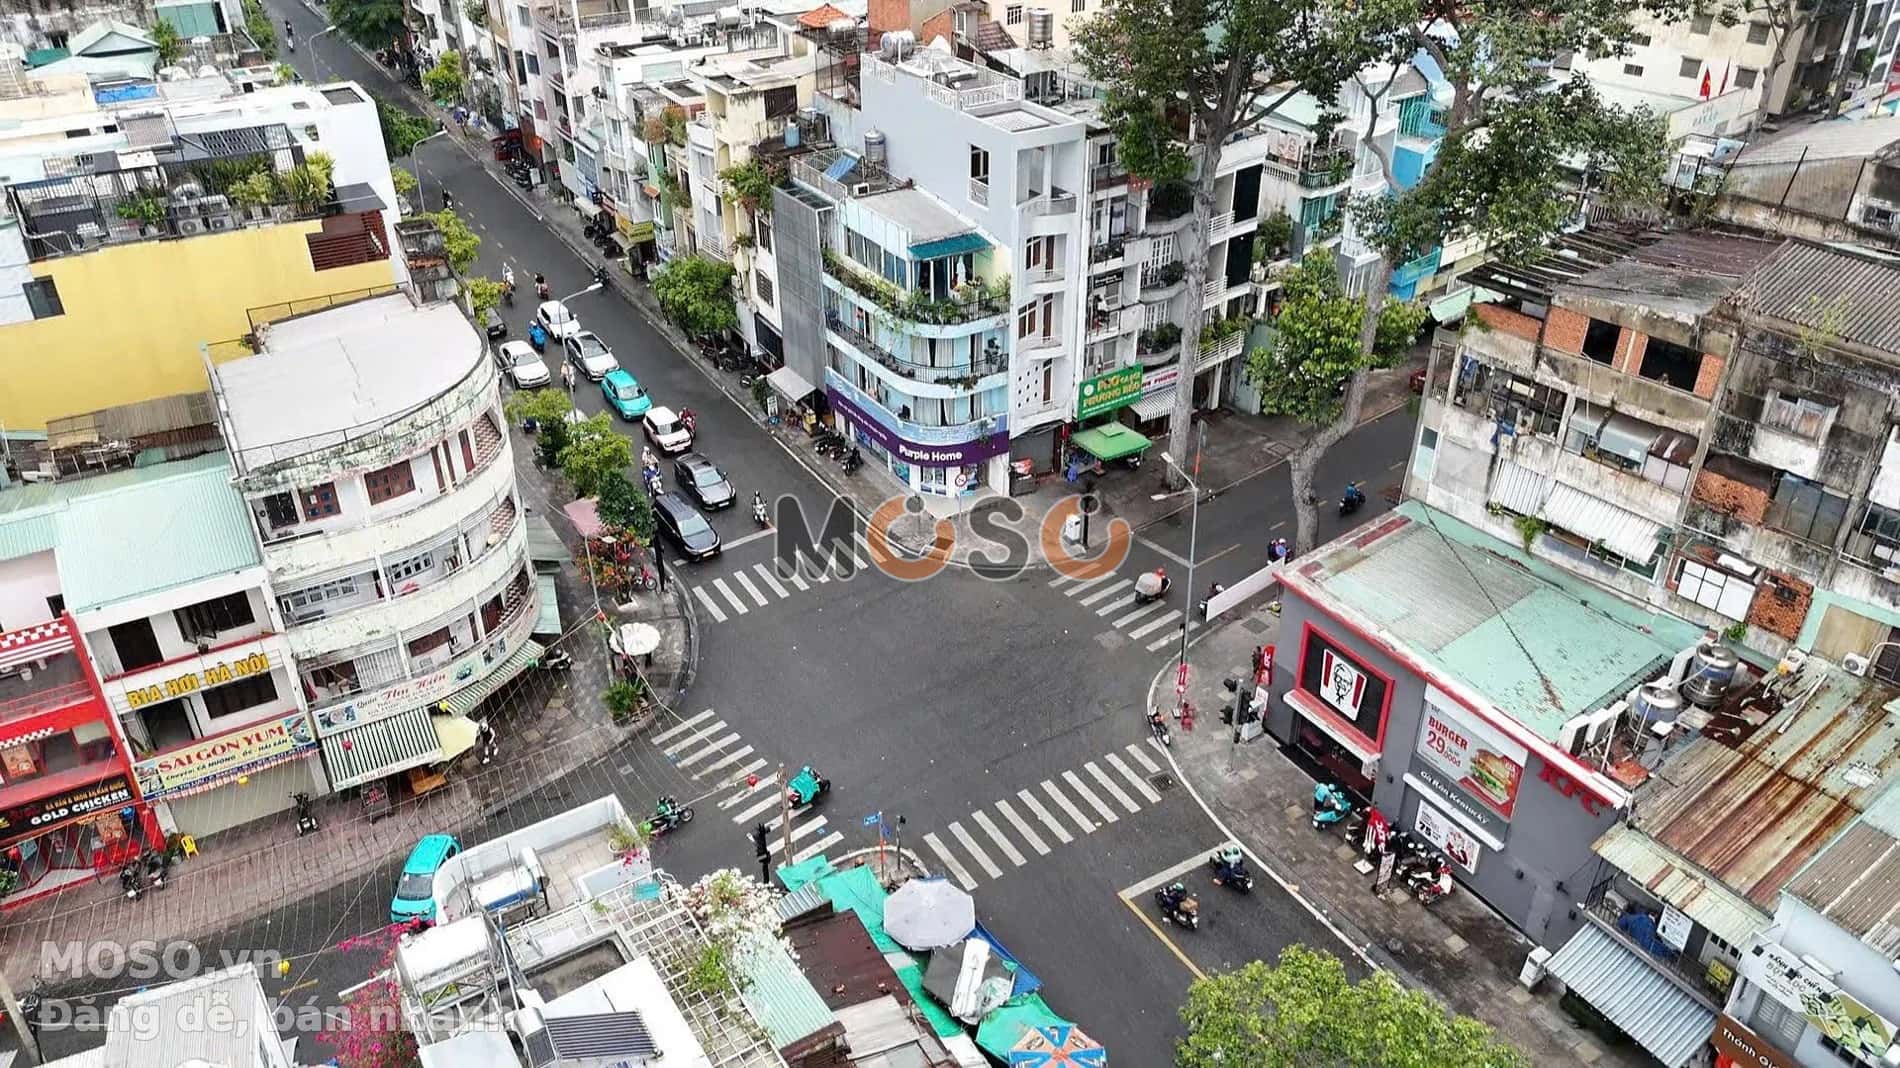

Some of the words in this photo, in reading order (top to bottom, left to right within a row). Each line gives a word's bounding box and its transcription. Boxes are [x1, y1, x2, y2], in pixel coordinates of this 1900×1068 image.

[899, 444, 930, 461] Purple
[931, 451, 963, 461] Home
[126, 684, 163, 709] BIA
[203, 661, 233, 686] HÀ
[243, 725, 285, 746] YUM
[1427, 716, 1469, 750] BURGER
[30, 807, 69, 826] GOLD
[71, 788, 129, 813] CHICKEN
[1449, 792, 1489, 824] Kentucky
